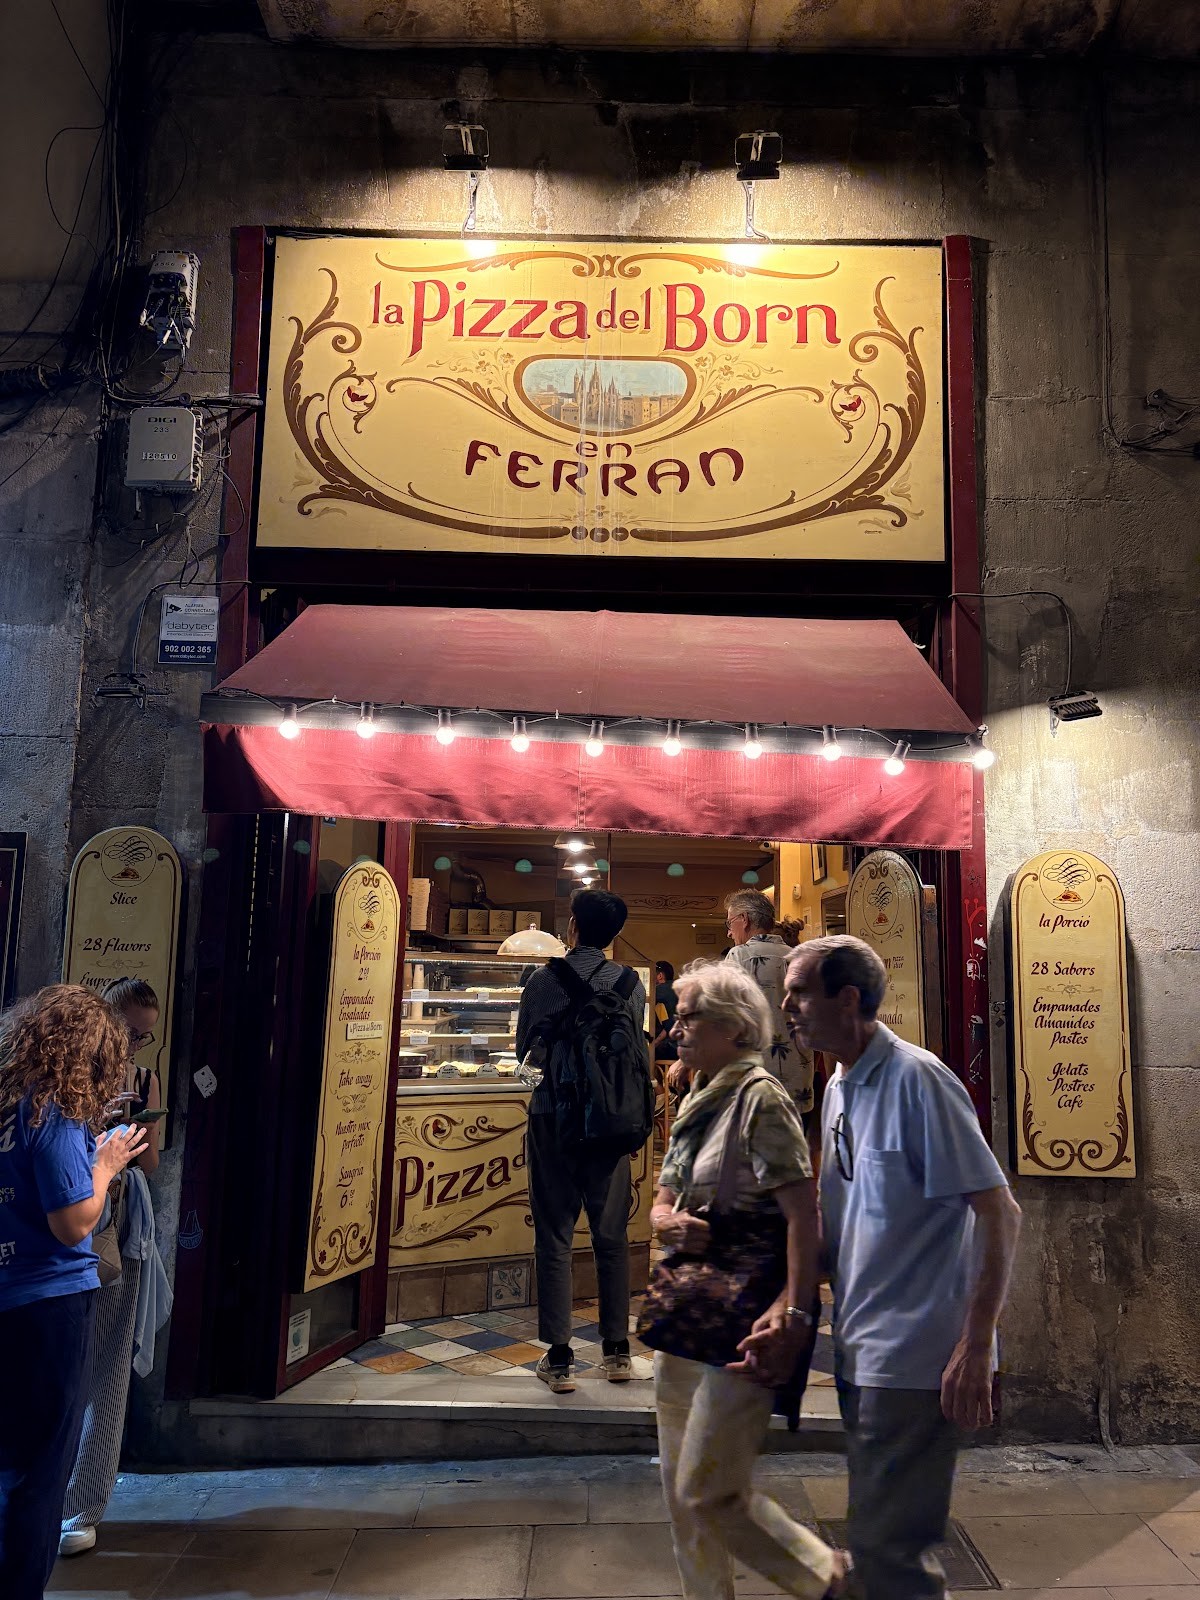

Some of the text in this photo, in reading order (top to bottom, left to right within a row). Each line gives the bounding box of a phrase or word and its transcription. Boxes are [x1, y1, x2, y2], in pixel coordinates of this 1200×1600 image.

[372, 280, 841, 358] la Pizza del Born
[147, 416, 177, 424] DIGI
[576, 441, 632, 458] en
[465, 440, 744, 496] FERRAN
[166, 621, 215, 631] dabytec
[164, 644, 212, 654] 902 002 365
[110, 891, 138, 905] Slice
[1038, 912, 1051, 928] la
[82, 937, 103, 951] 28
[353, 943, 360, 960] la
[1030, 961, 1096, 976] 28 Sabors
[1032, 996, 1101, 1018] Empanades
[1034, 1014, 1096, 1030] Amanides
[1048, 1031, 1089, 1051] Pastes
[355, 1073, 374, 1089] away
[1050, 1077, 1096, 1097] Postres
[1057, 1094, 1084, 1114] Cafe
[357, 1117, 371, 1131] mix
[391, 1156, 512, 1238] Pizza
